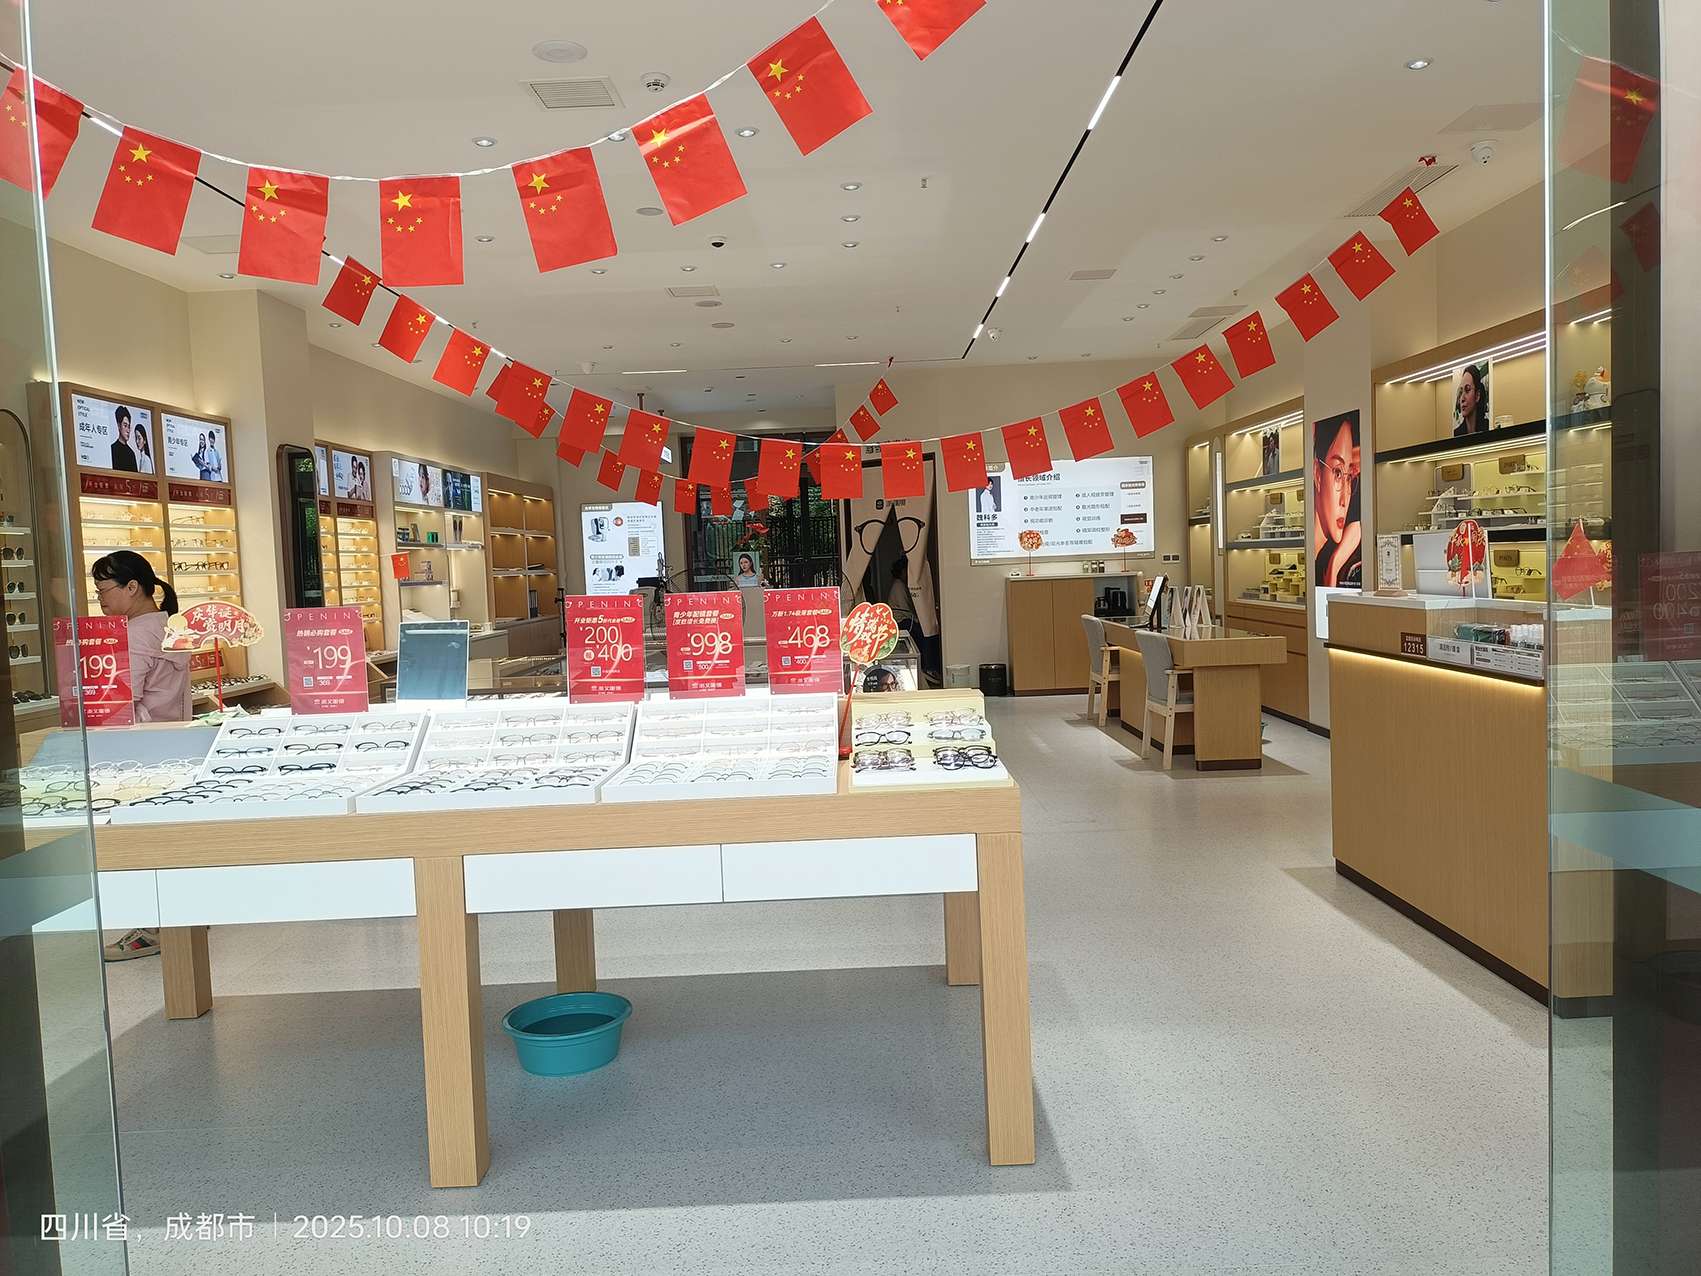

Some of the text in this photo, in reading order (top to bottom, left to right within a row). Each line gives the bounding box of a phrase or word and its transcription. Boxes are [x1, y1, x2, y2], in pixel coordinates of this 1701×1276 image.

[79, 422, 108, 436] 成年人专区
[1404, 642, 1424, 654] 12315
[80, 654, 116, 678] 199
